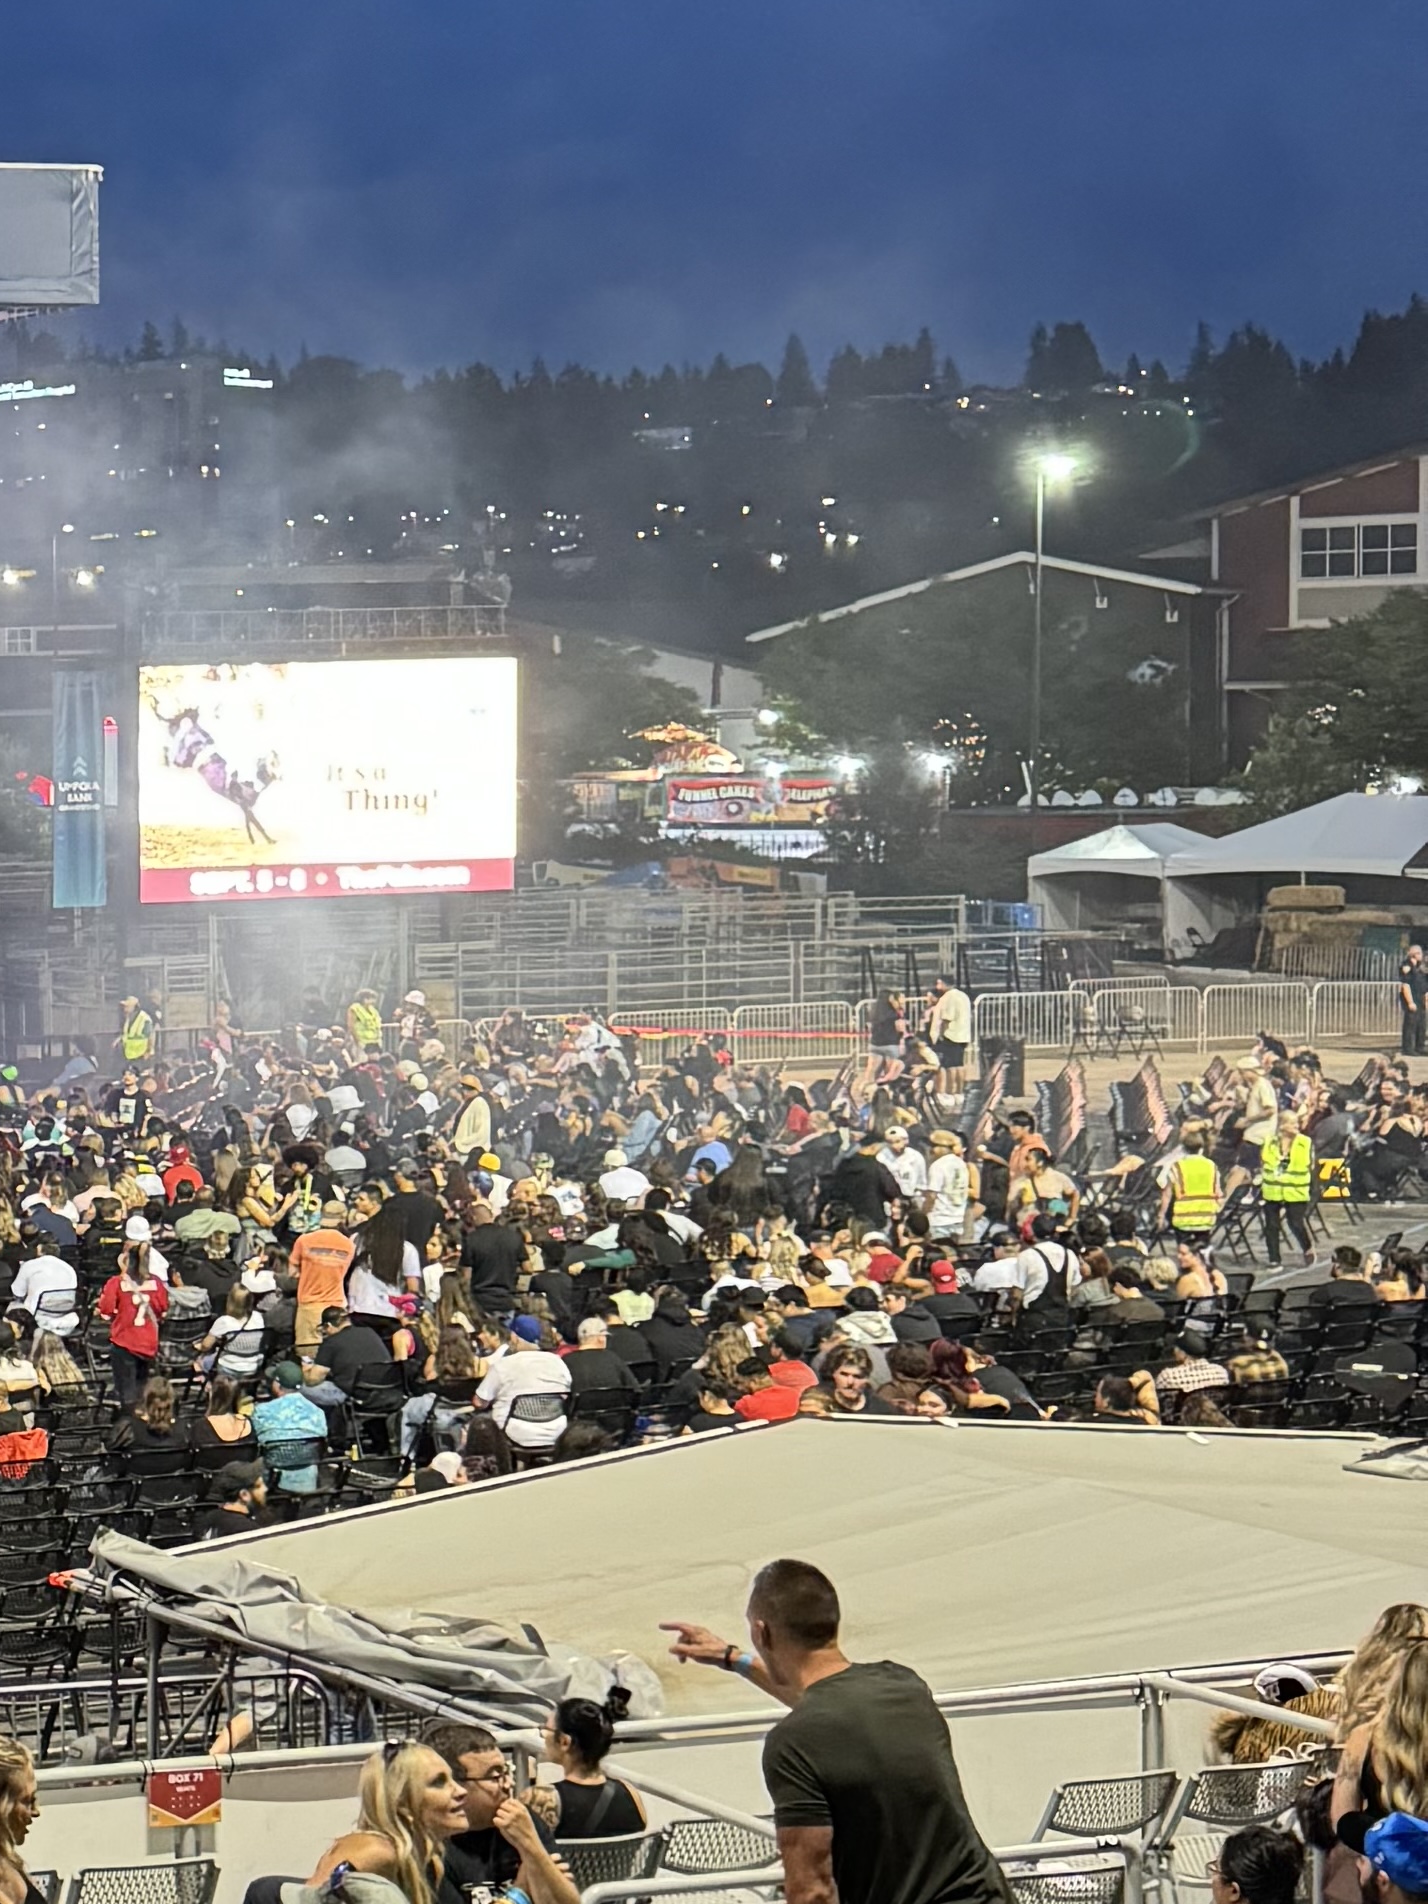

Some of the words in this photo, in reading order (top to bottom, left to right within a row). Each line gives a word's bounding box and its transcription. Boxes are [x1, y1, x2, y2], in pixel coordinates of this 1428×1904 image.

[327, 763, 367, 782] Its
[167, 1773, 191, 1784] BOX
[192, 1772, 204, 1782] 71
